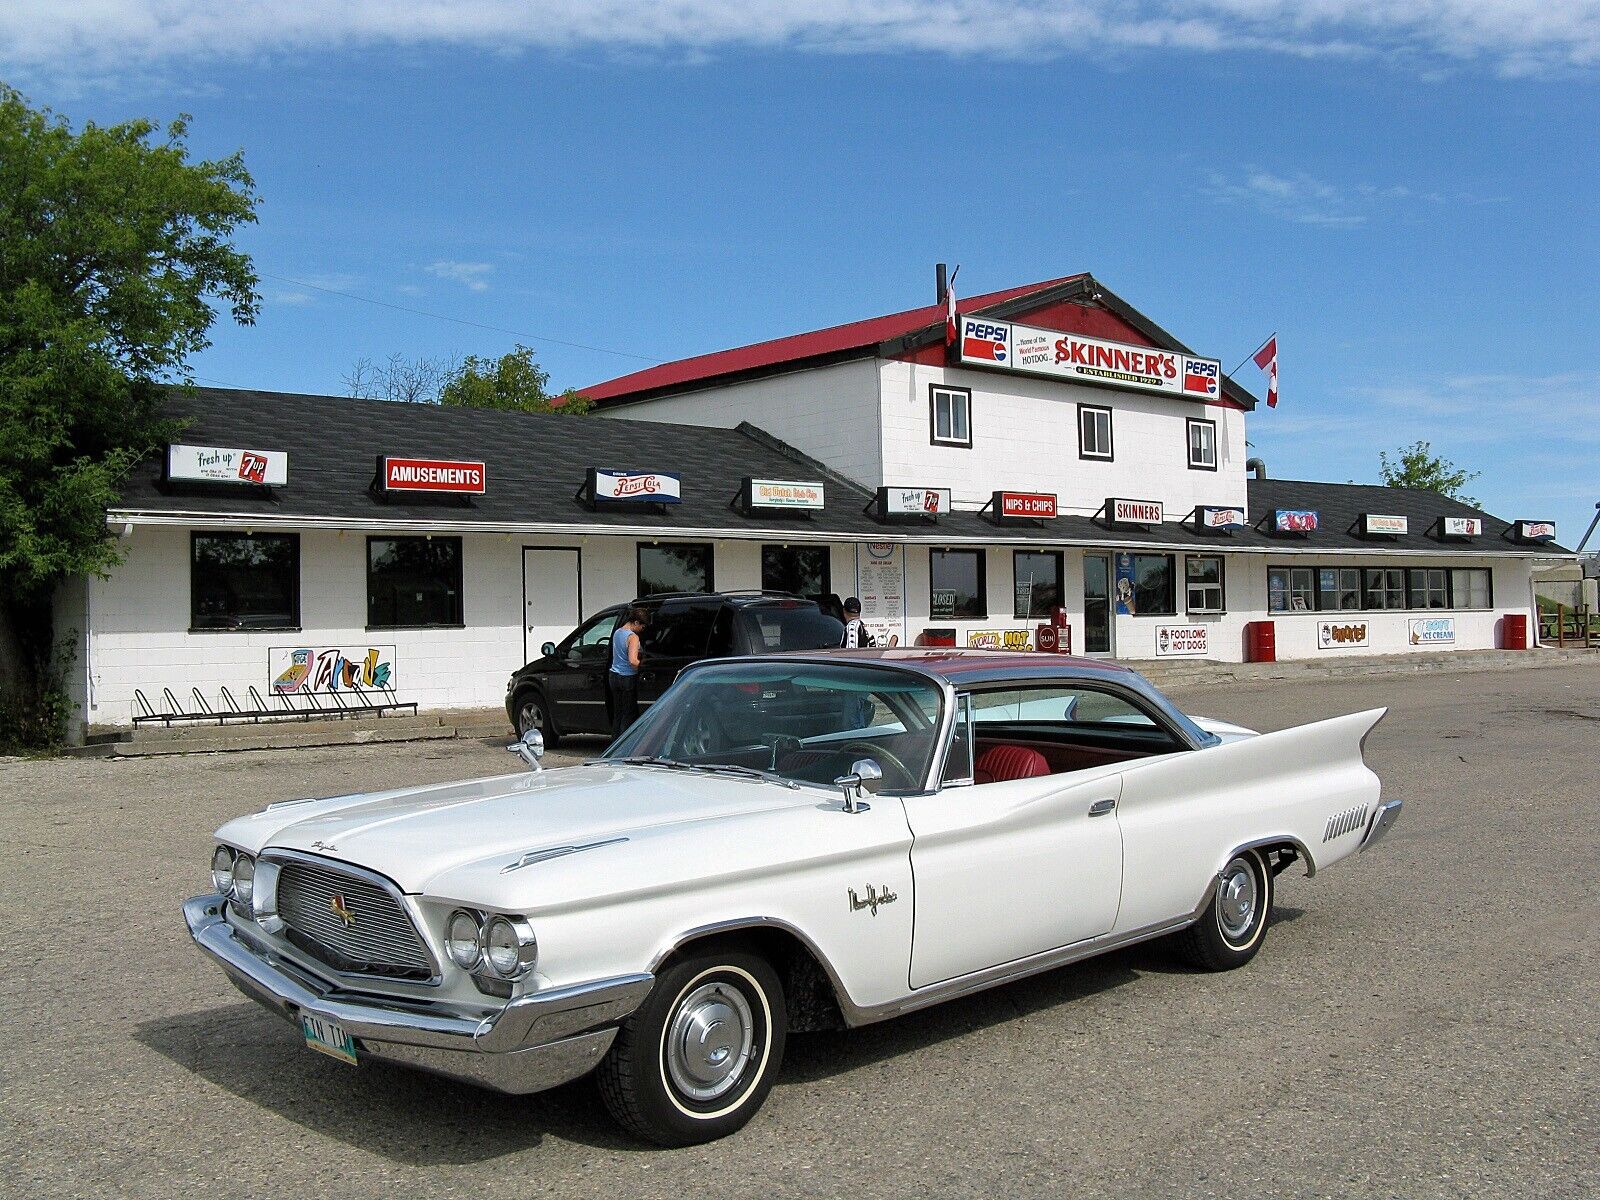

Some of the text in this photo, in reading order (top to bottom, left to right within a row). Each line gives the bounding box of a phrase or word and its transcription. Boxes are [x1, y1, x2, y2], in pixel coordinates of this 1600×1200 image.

[965, 322, 1007, 342] PEPSI
[1054, 336, 1177, 379] SKINNER'S
[1185, 360, 1218, 377] PEPSI
[1083, 368, 1157, 385] ESTABLISHED 1929
[390, 465, 480, 485] AMUSEMENTS
[1006, 498, 1053, 512] NIPS & CHIPS
[1117, 503, 1160, 520] SKINNERS
[1425, 619, 1451, 632] SOFT
[971, 636, 997, 648] WORLD
[1003, 630, 1030, 647] HOT
[1040, 634, 1055, 643] SUN
[1170, 629, 1206, 640] FOOTLONG
[1422, 630, 1454, 640] ICE CREAM
[1172, 640, 1207, 651] HOT DOGS
